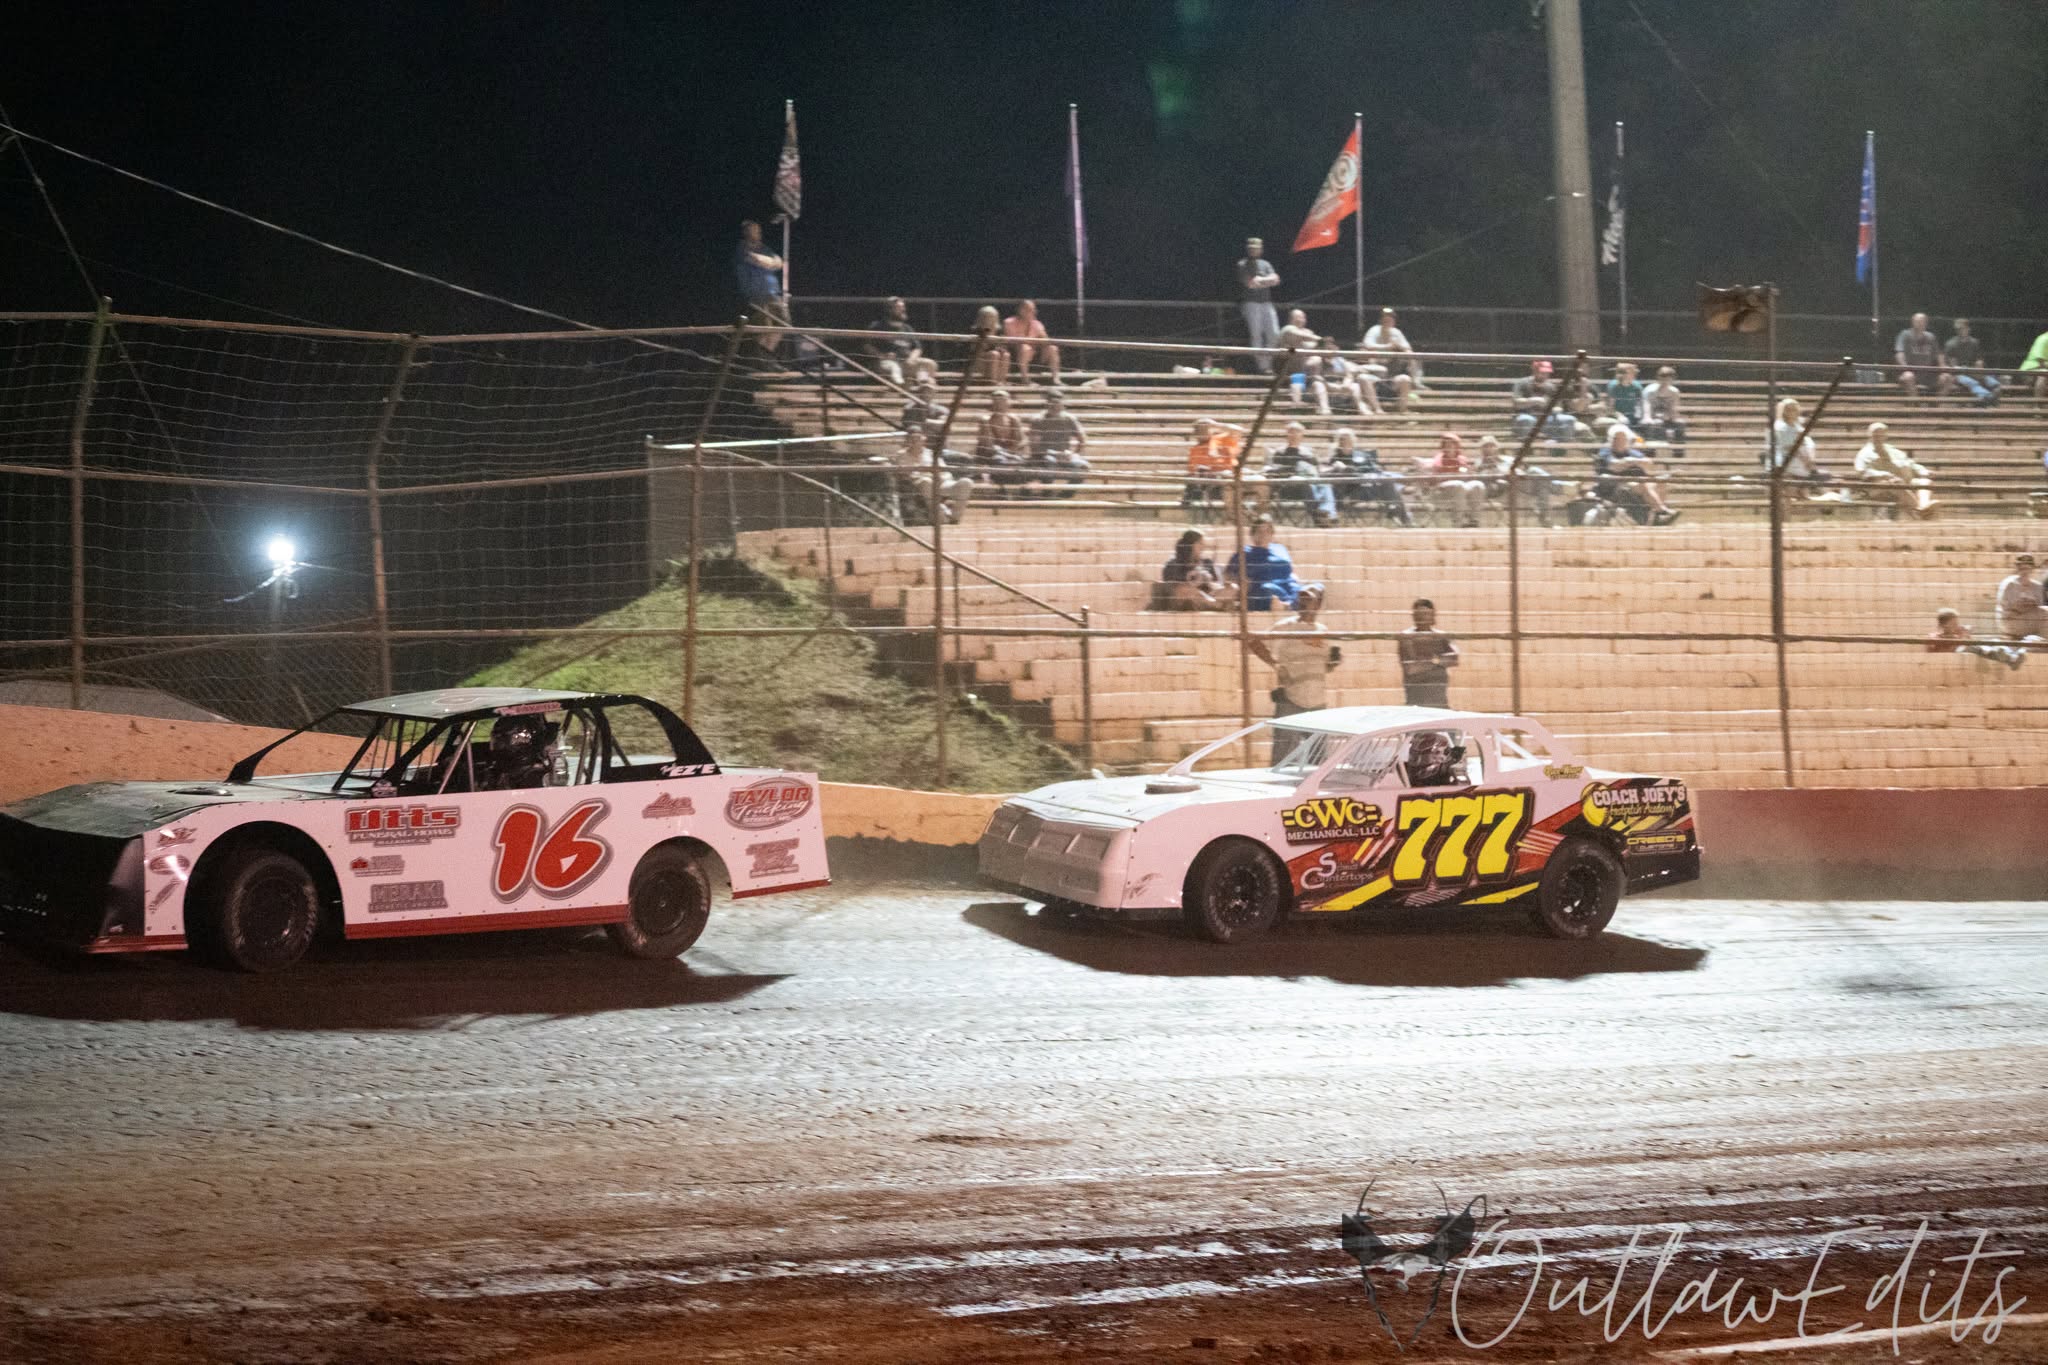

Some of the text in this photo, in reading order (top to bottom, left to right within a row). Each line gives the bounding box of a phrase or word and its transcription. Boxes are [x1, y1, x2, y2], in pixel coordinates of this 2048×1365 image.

[733, 786, 810, 804] TAYLOR
[1592, 785, 1687, 806] COACH JOEY'S
[735, 800, 809, 820] Trucking
[352, 828, 454, 841] FUNERAL HOME
[1287, 826, 1380, 841] MECHANICAL, LLC
[1392, 792, 1527, 882] 777
[496, 799, 609, 901] 16
